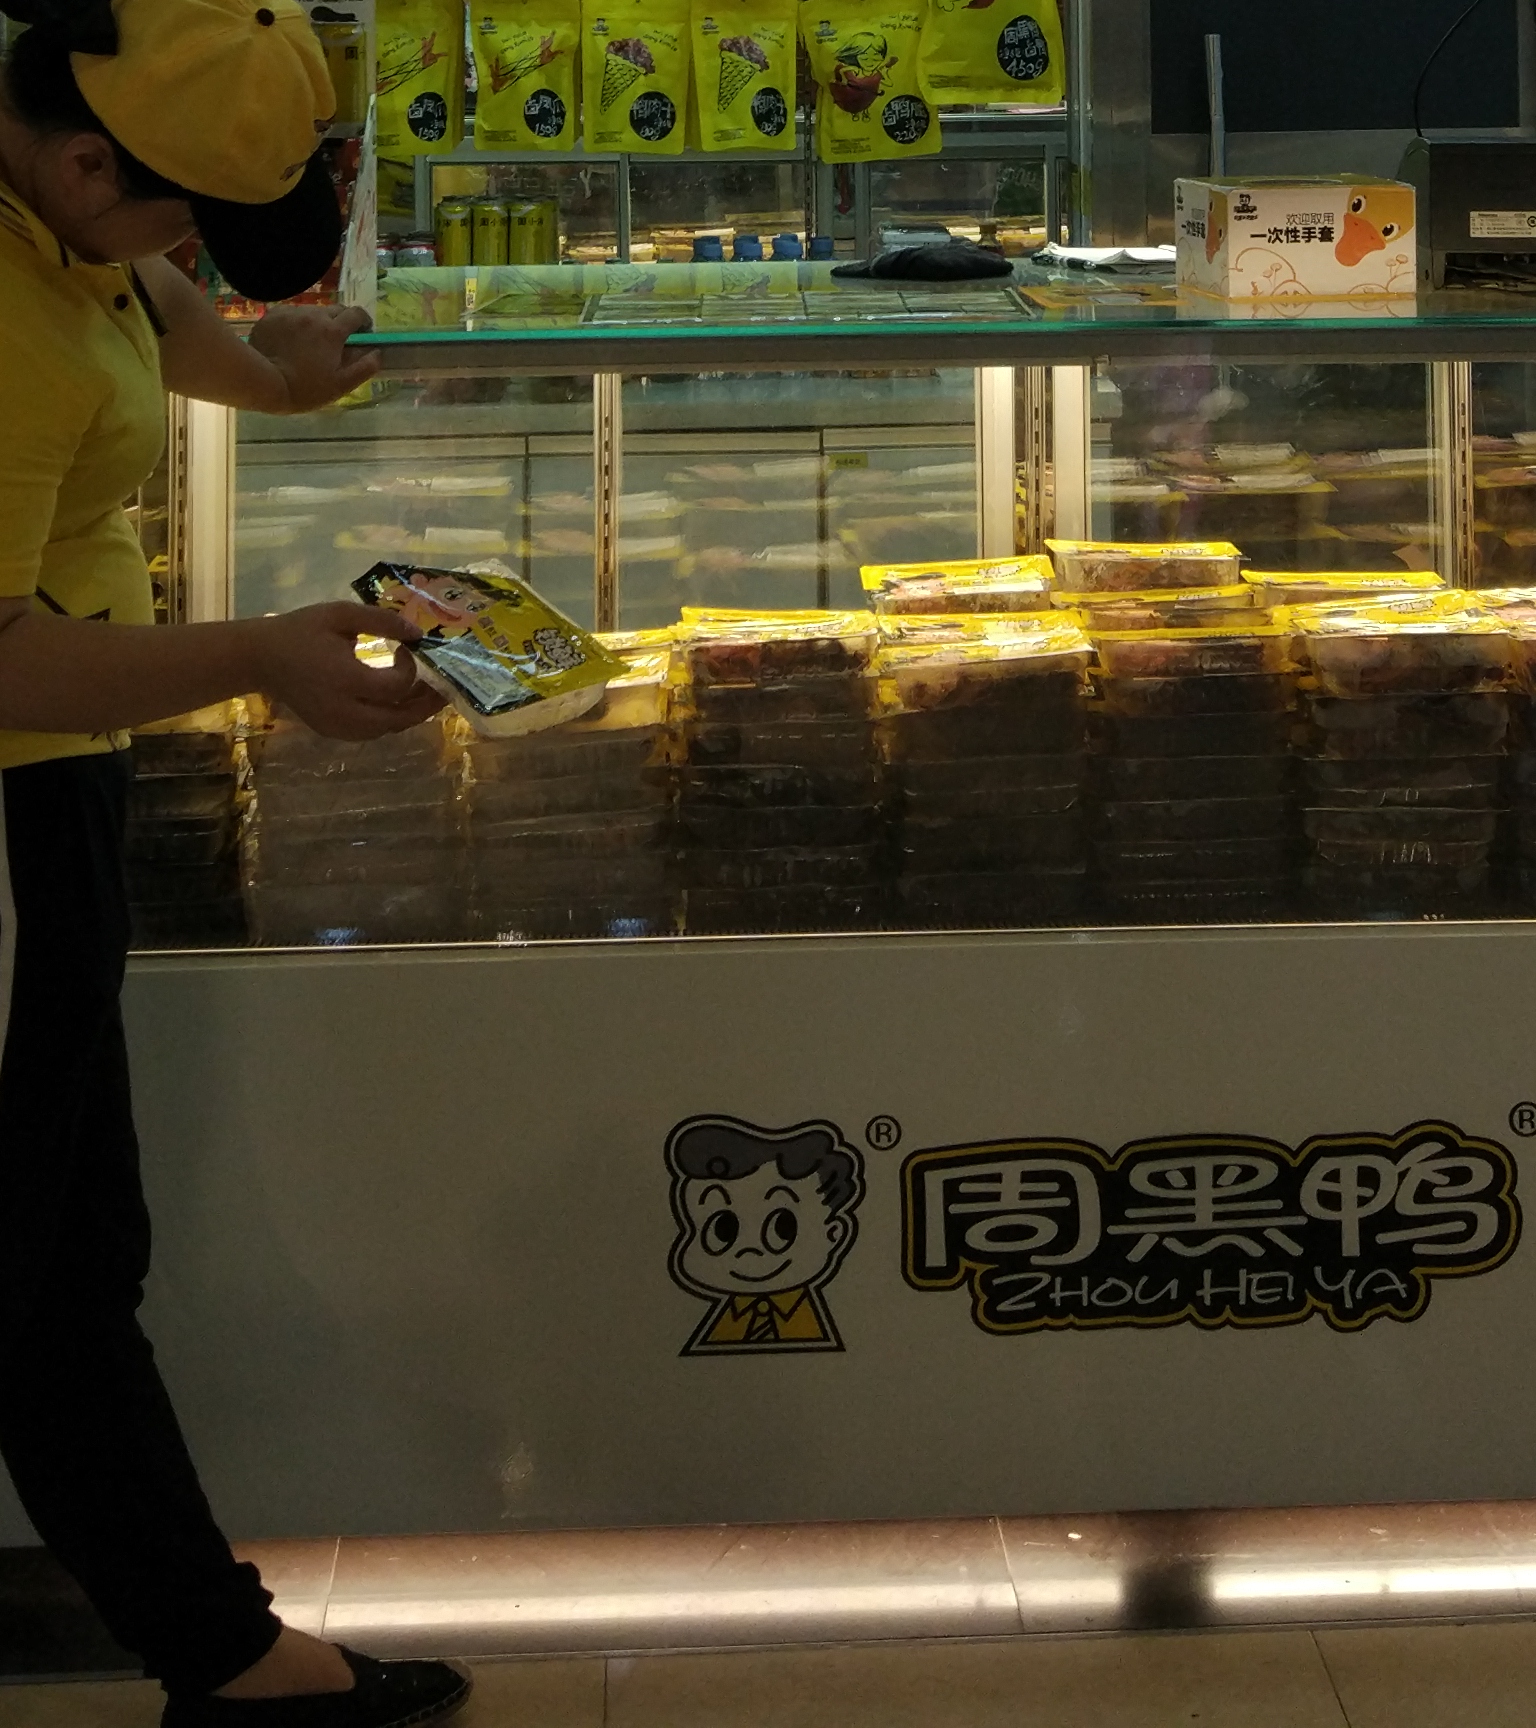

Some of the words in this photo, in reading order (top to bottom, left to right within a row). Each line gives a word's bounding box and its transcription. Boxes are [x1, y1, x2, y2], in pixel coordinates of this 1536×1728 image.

[1285, 211, 1336, 227] 欢迎取用
[1249, 226, 1336, 245] 一次性手套
[924, 1141, 1501, 1268] 周黑鸭
[992, 1273, 1179, 1314] ZHOU
[1195, 1268, 1299, 1308] HEI
[1311, 1269, 1409, 1311] YA
